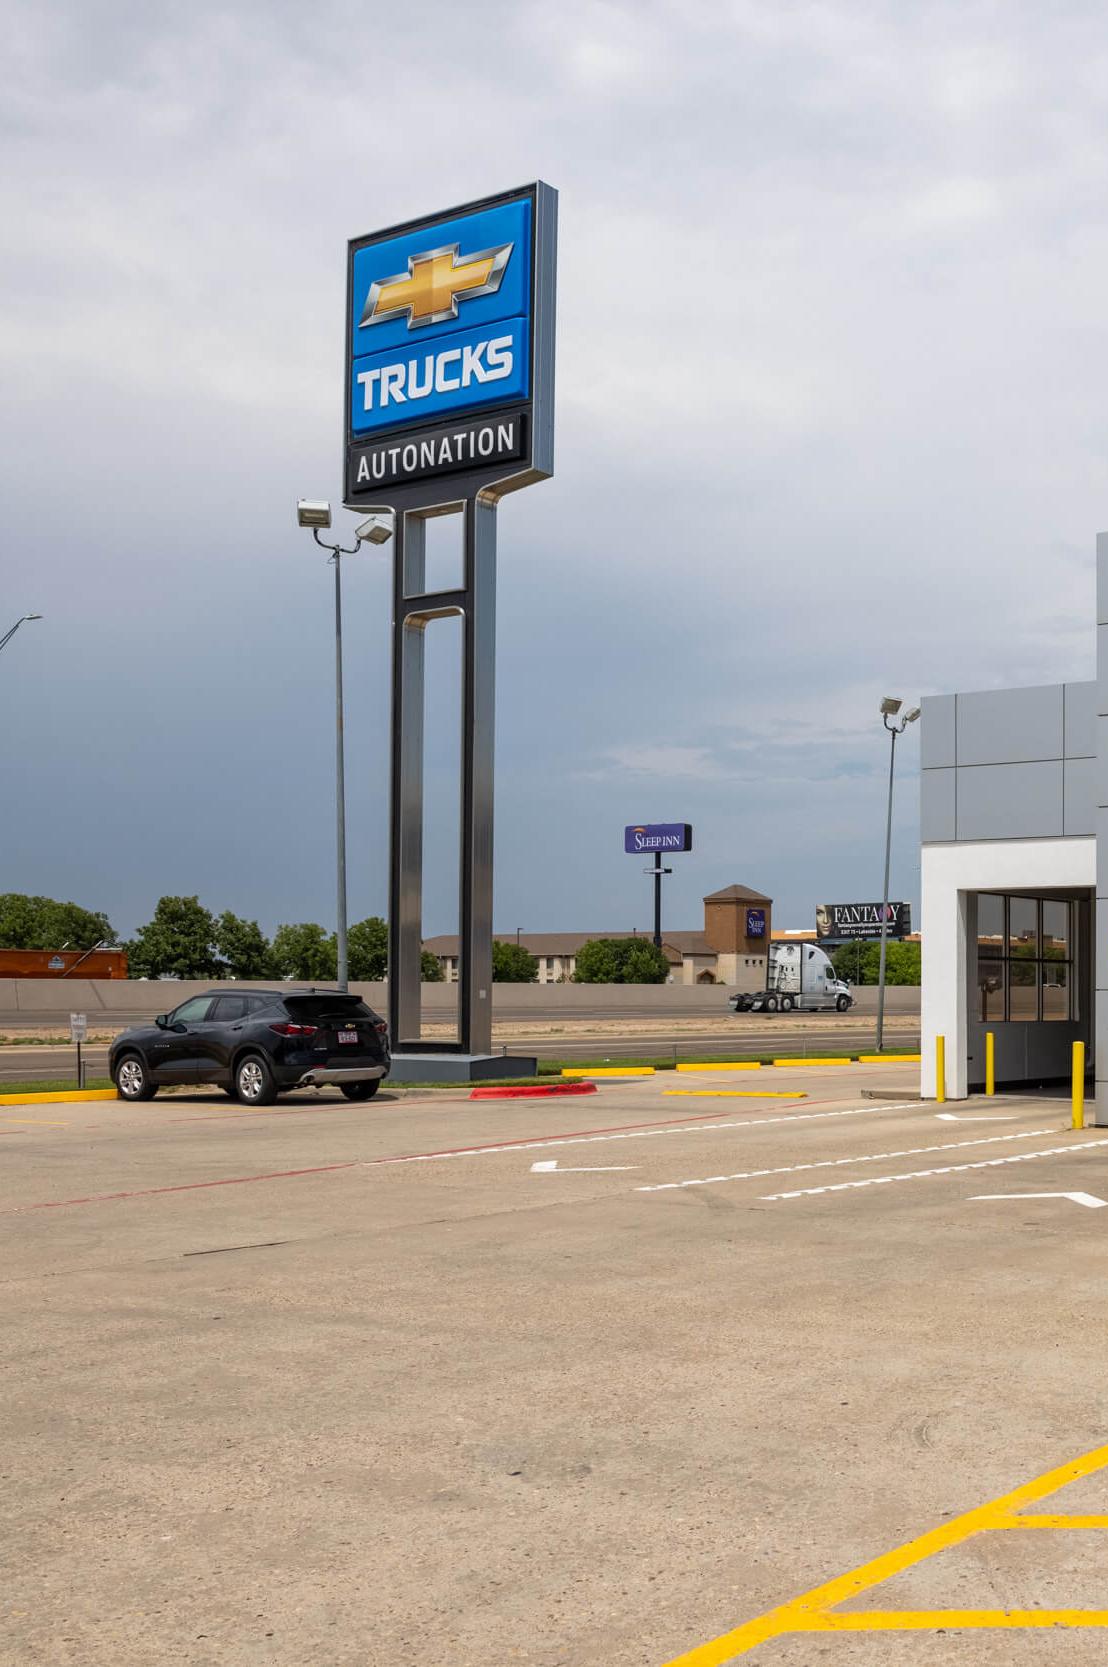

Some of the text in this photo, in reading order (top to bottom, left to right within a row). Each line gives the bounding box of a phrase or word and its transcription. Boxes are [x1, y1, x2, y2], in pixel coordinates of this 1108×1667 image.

[357, 335, 514, 411] TRUCKS
[356, 423, 514, 483] AUTONATION
[635, 833, 680, 850] SLEEP INN
[834, 904, 900, 923] FANTAY
